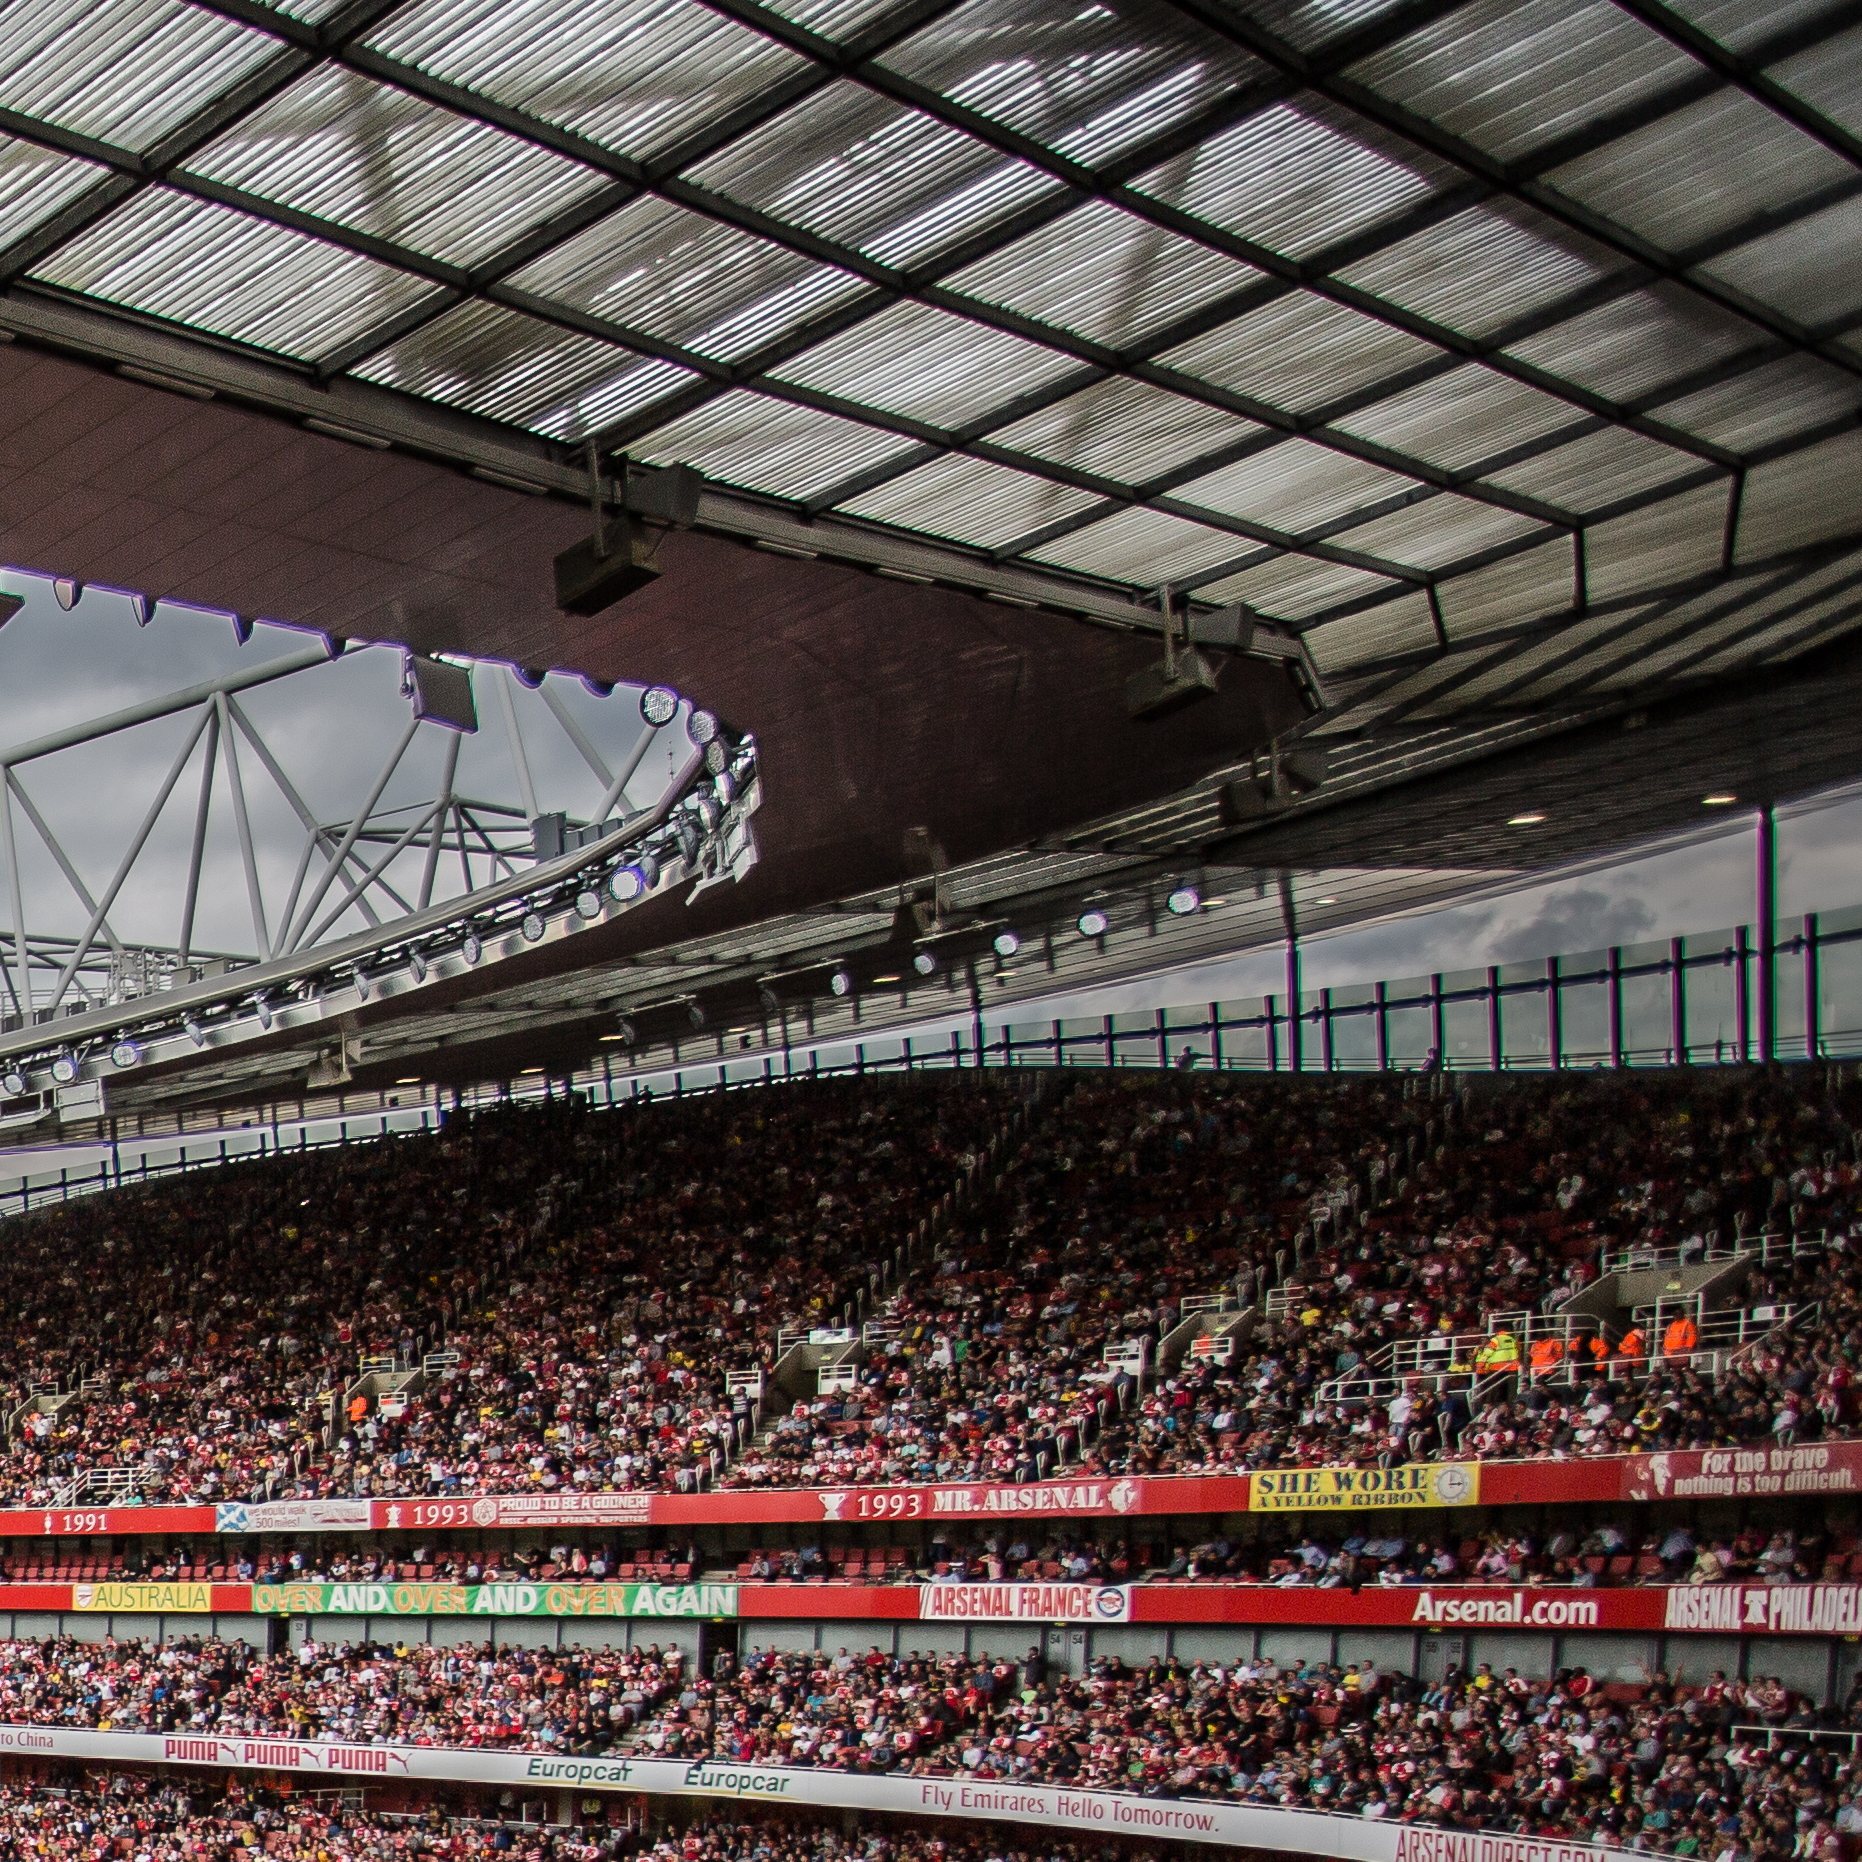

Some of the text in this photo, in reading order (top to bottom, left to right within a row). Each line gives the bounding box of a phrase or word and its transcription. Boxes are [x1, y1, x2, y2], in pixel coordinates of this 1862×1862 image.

[1257, 1467, 1429, 1497] SHE WORE
[1673, 1476, 1734, 1496] nothing
[1736, 1475, 1751, 1493] is
[1754, 1474, 1782, 1493] too
[498, 1495, 648, 1511] PROUD TO BE A GOONER!
[857, 1493, 922, 1519] 1993
[1256, 1491, 1428, 1509] A YELLOW RIBBON
[62, 1513, 108, 1532] 1991
[255, 1516, 274, 1529] 500
[413, 1505, 469, 1525] 1993
[94, 1586, 207, 1610] AUSTRALIA
[256, 1585, 736, 1615] OVER AND OVER AND OVER AGAIN
[930, 1586, 1092, 1618] ARSENAL FRANCE
[1412, 1592, 1599, 1627] Arsenal.com
[1664, 1586, 1742, 1630] ARSENAL
[0, 1731, 14, 1747] to
[17, 1730, 55, 1749] China
[165, 1738, 389, 1773] PUMA PUMA PUMA
[685, 1767, 791, 1796] Europcar
[921, 1784, 1220, 1834] Fly Emirates. Hello Tomorrow.
